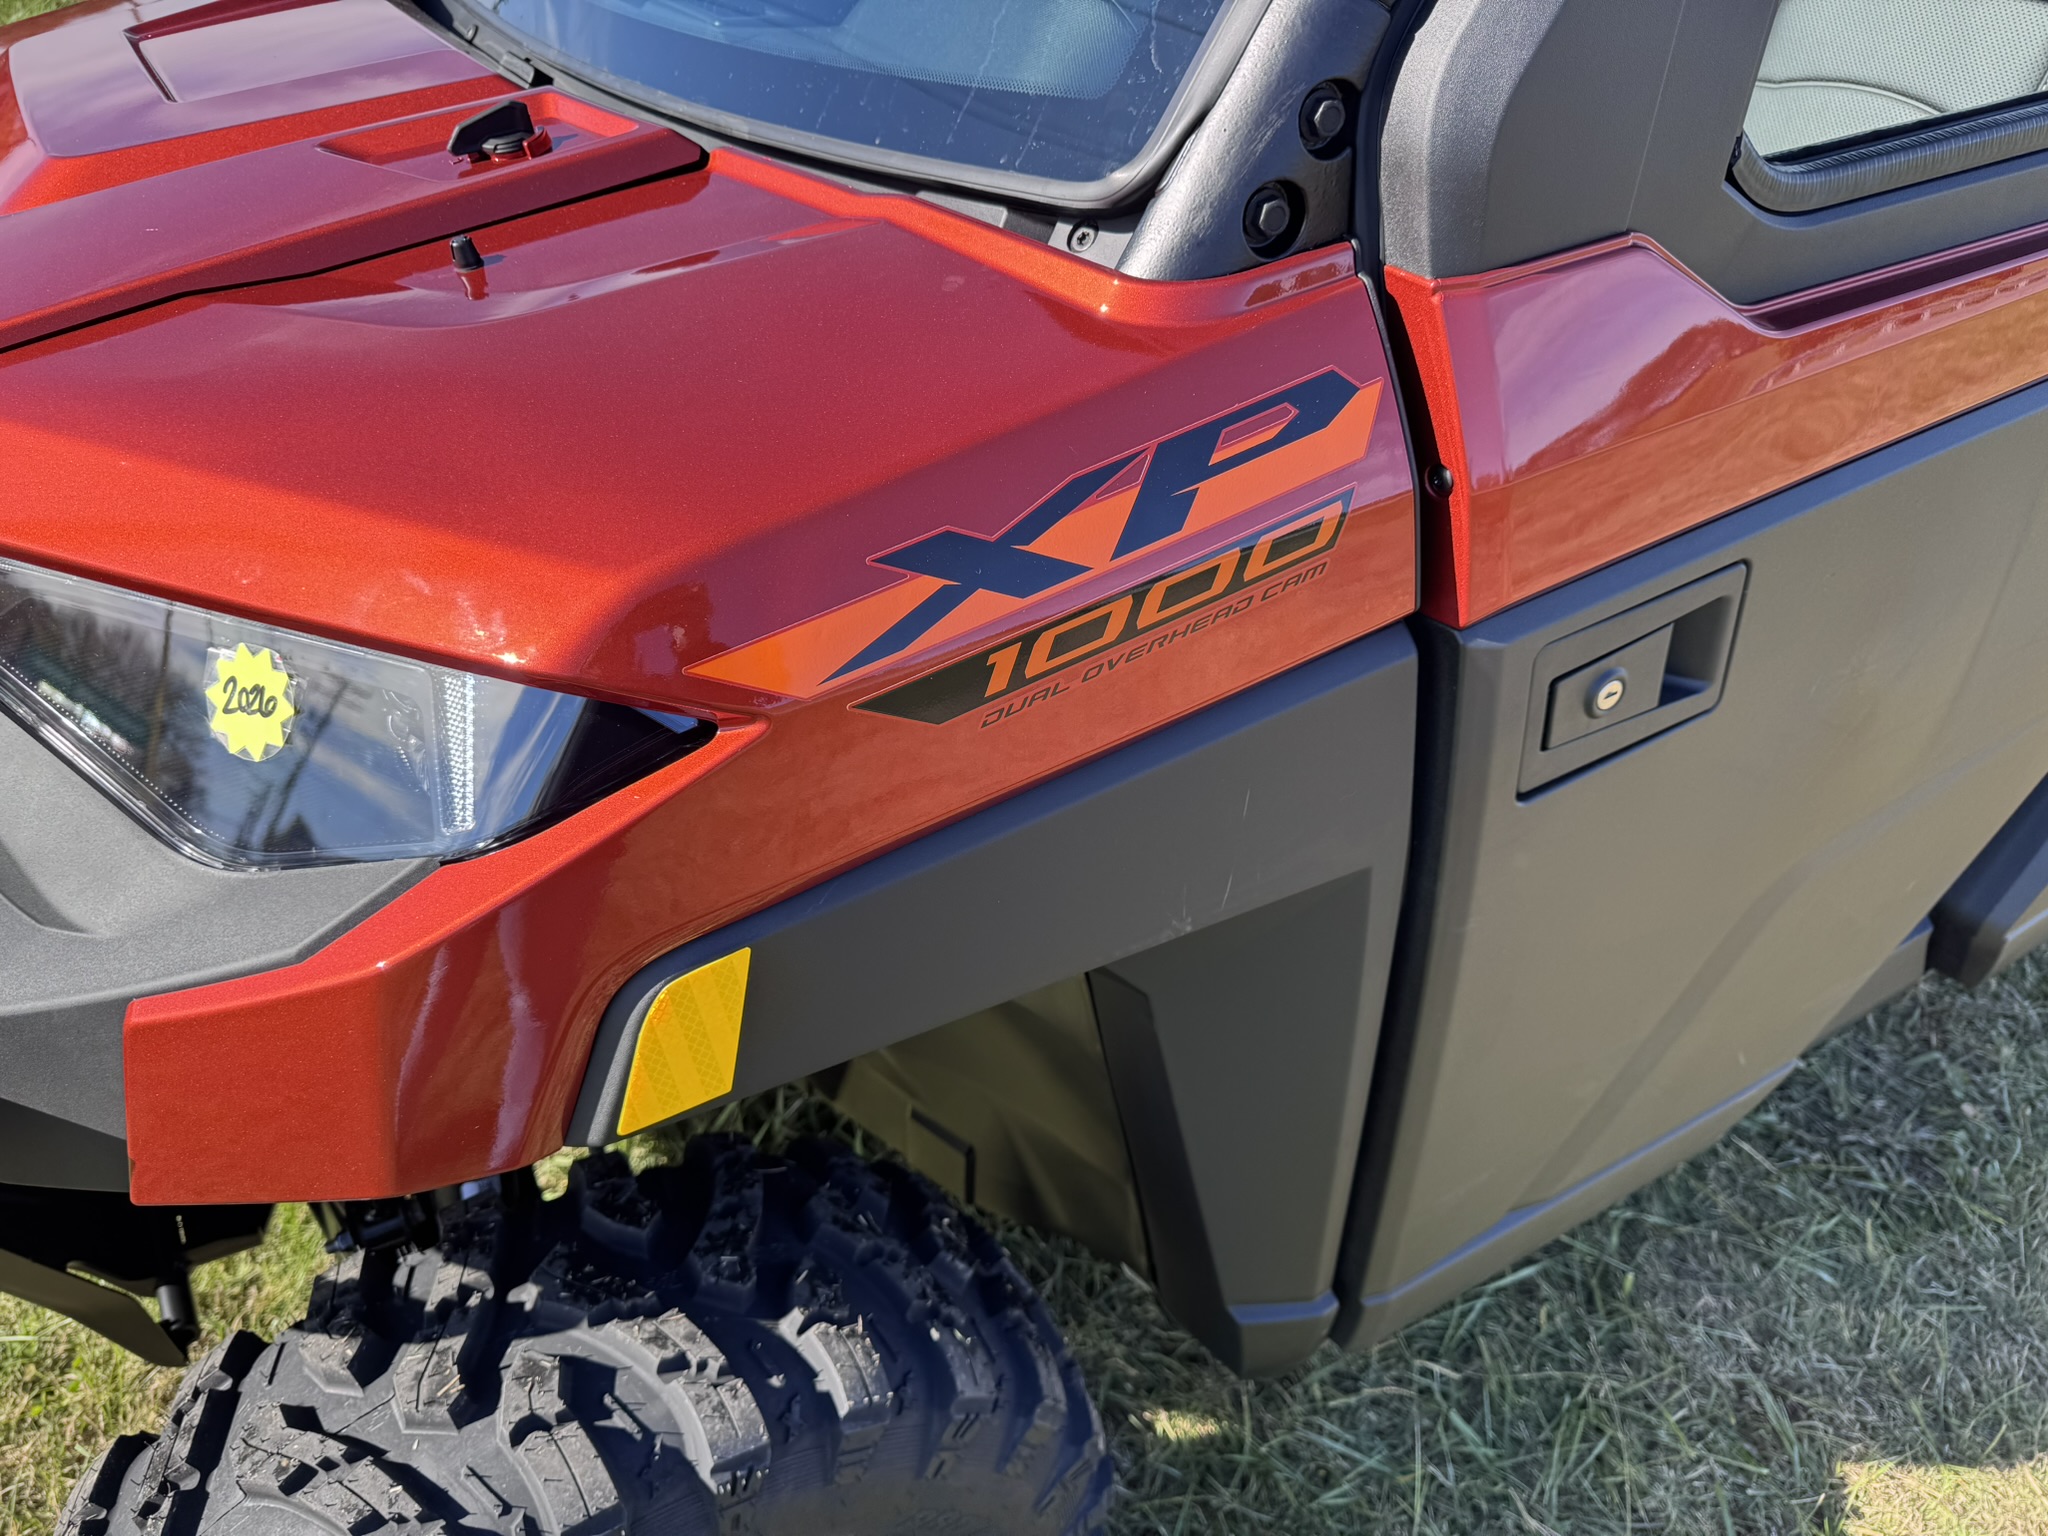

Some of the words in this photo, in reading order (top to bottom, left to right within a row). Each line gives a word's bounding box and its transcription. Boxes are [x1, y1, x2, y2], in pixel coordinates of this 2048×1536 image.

[817, 368, 1361, 686] XP
[984, 502, 1343, 697] 1000
[222, 675, 278, 718] 2026
[981, 681, 1070, 728] DUAL
[1081, 595, 1255, 683] OVERHEAD
[1260, 561, 1327, 603] CAM
